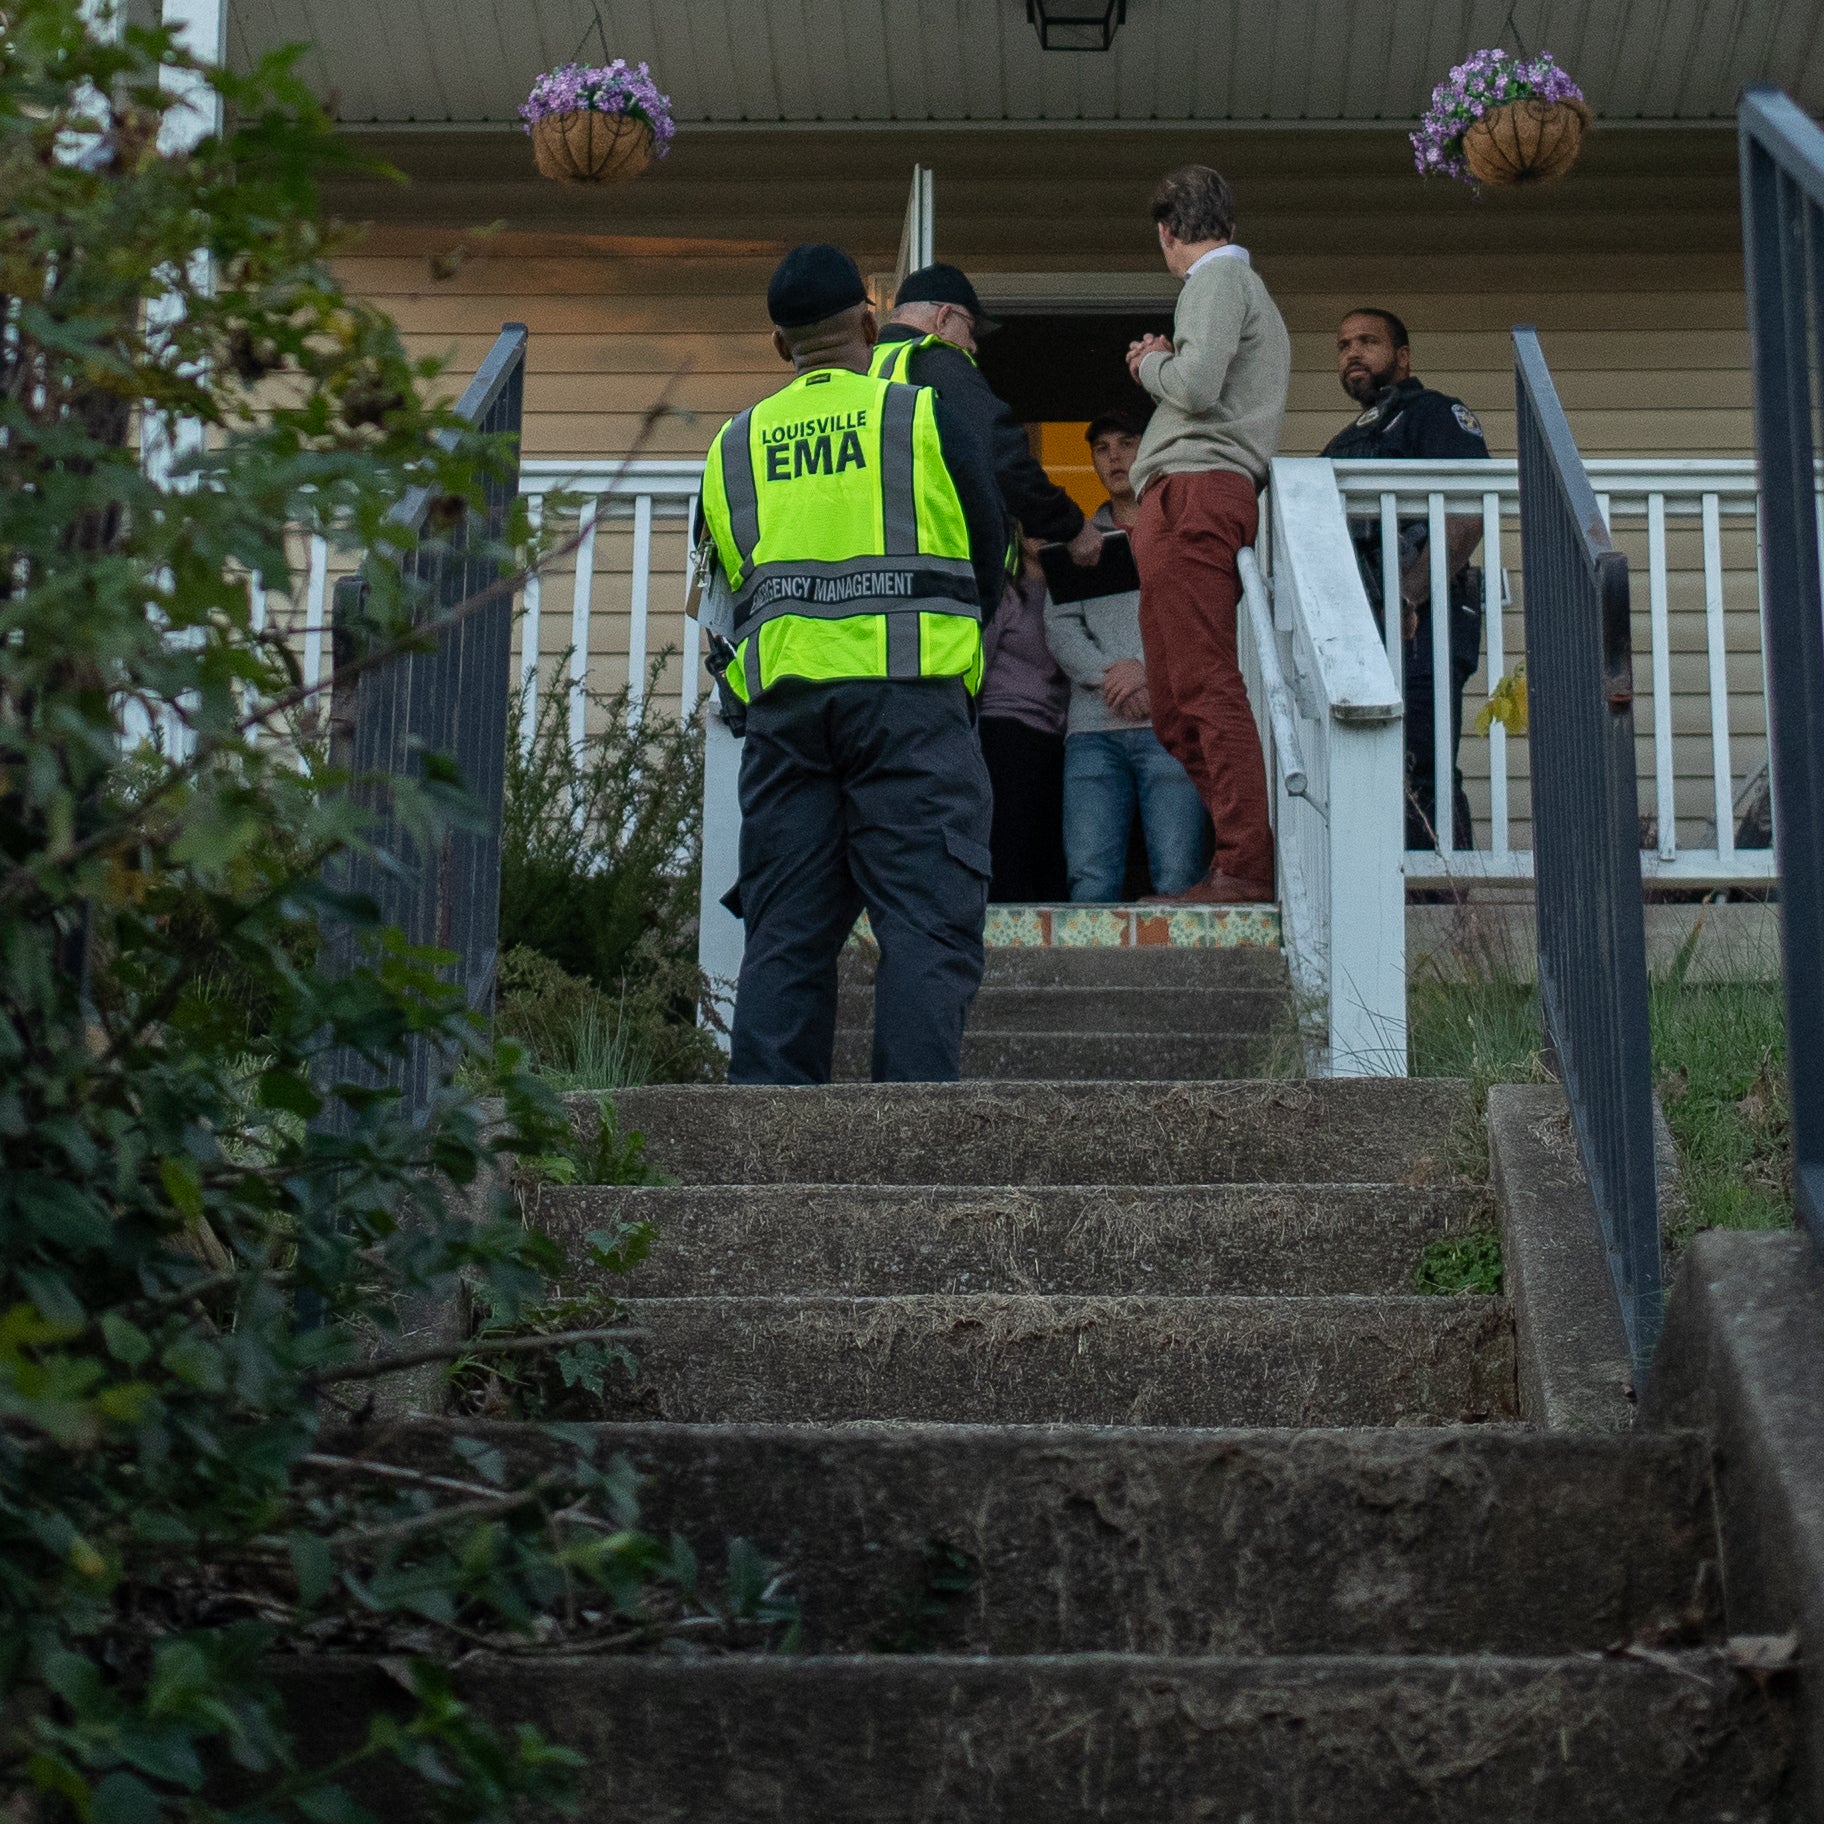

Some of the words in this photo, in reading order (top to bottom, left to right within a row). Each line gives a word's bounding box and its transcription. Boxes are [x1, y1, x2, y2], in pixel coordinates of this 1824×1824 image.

[762, 409, 867, 445] LOUISVILLE
[766, 429, 867, 482] EMA
[813, 572, 914, 602] MANAGEMENT
